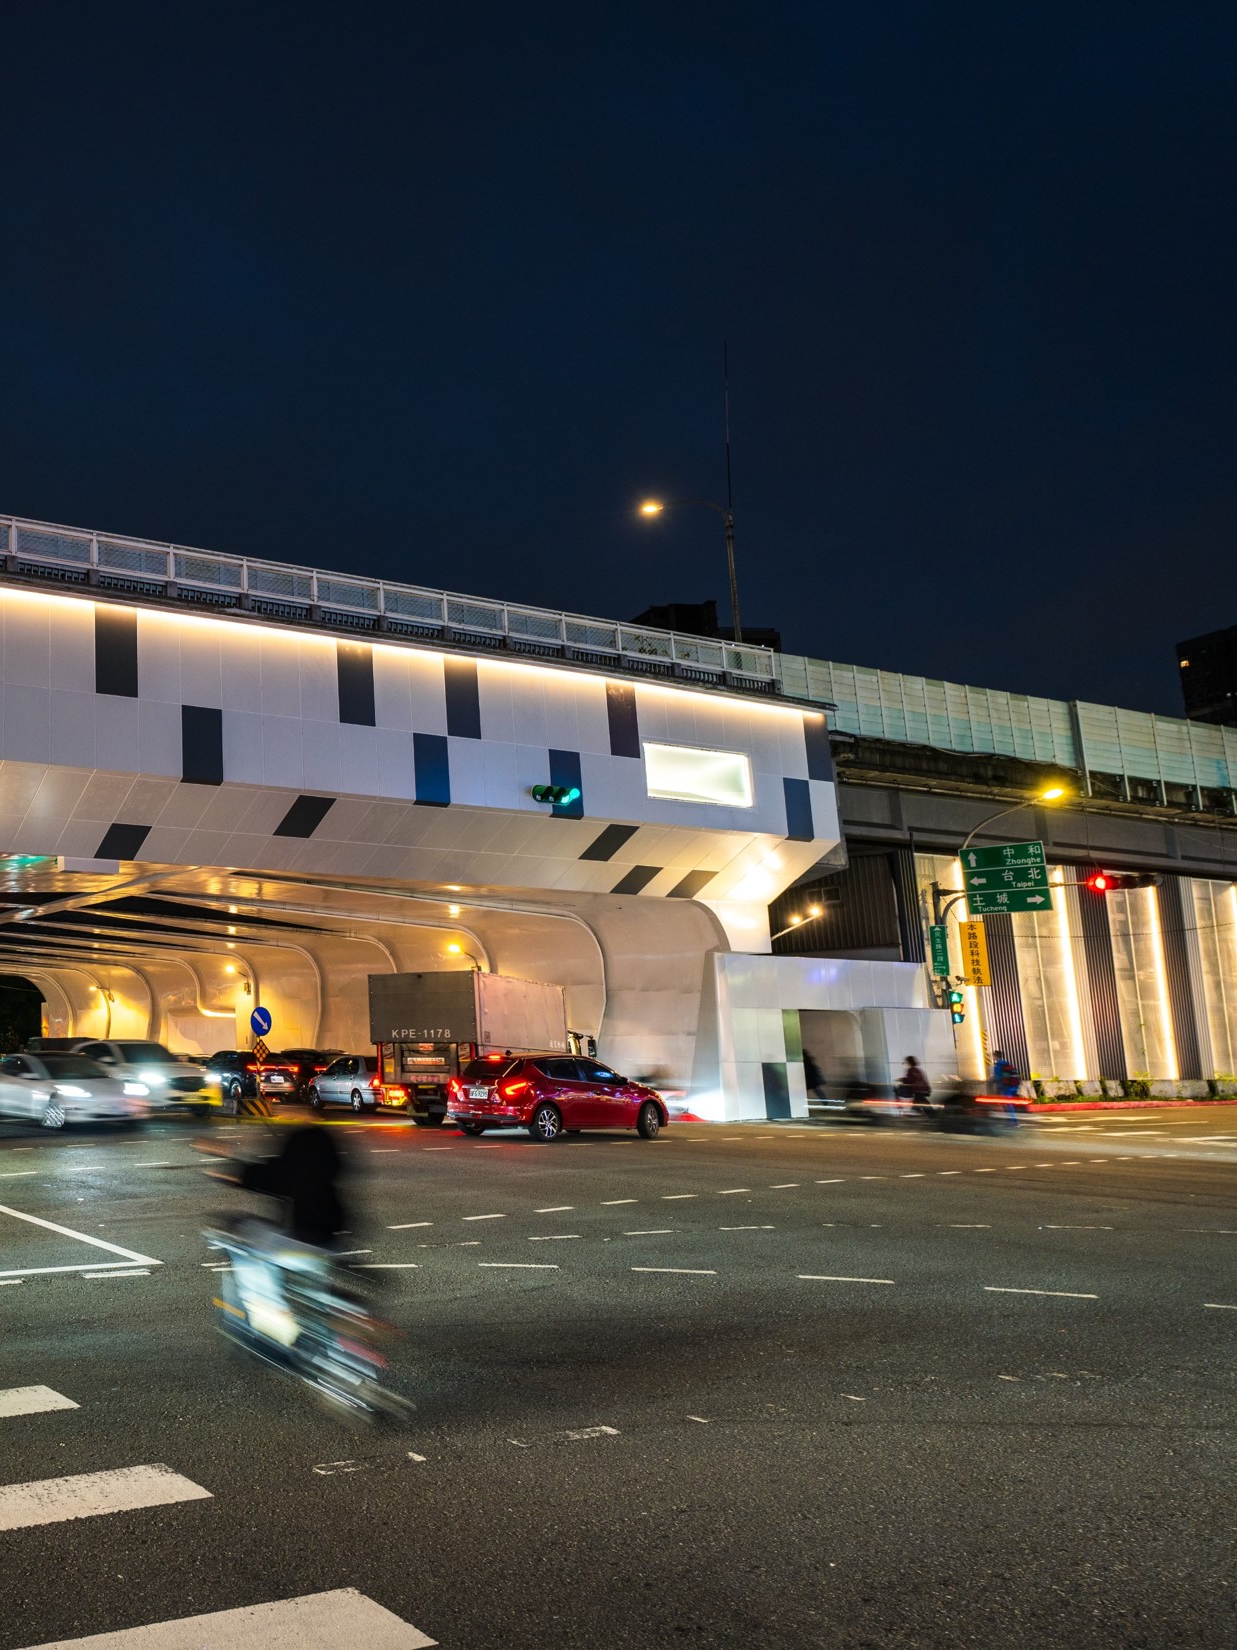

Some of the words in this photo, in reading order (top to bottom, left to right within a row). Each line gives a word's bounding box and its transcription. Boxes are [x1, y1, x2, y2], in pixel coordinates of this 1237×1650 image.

[1003, 845, 1041, 858] 中和
[1006, 857, 1041, 866] Zhonghe
[1002, 867, 1041, 881] 台北
[973, 892, 1010, 906] 土城
[967, 923, 983, 984] 本路段科技執法
[392, 1029, 451, 1038] KPE-1178
